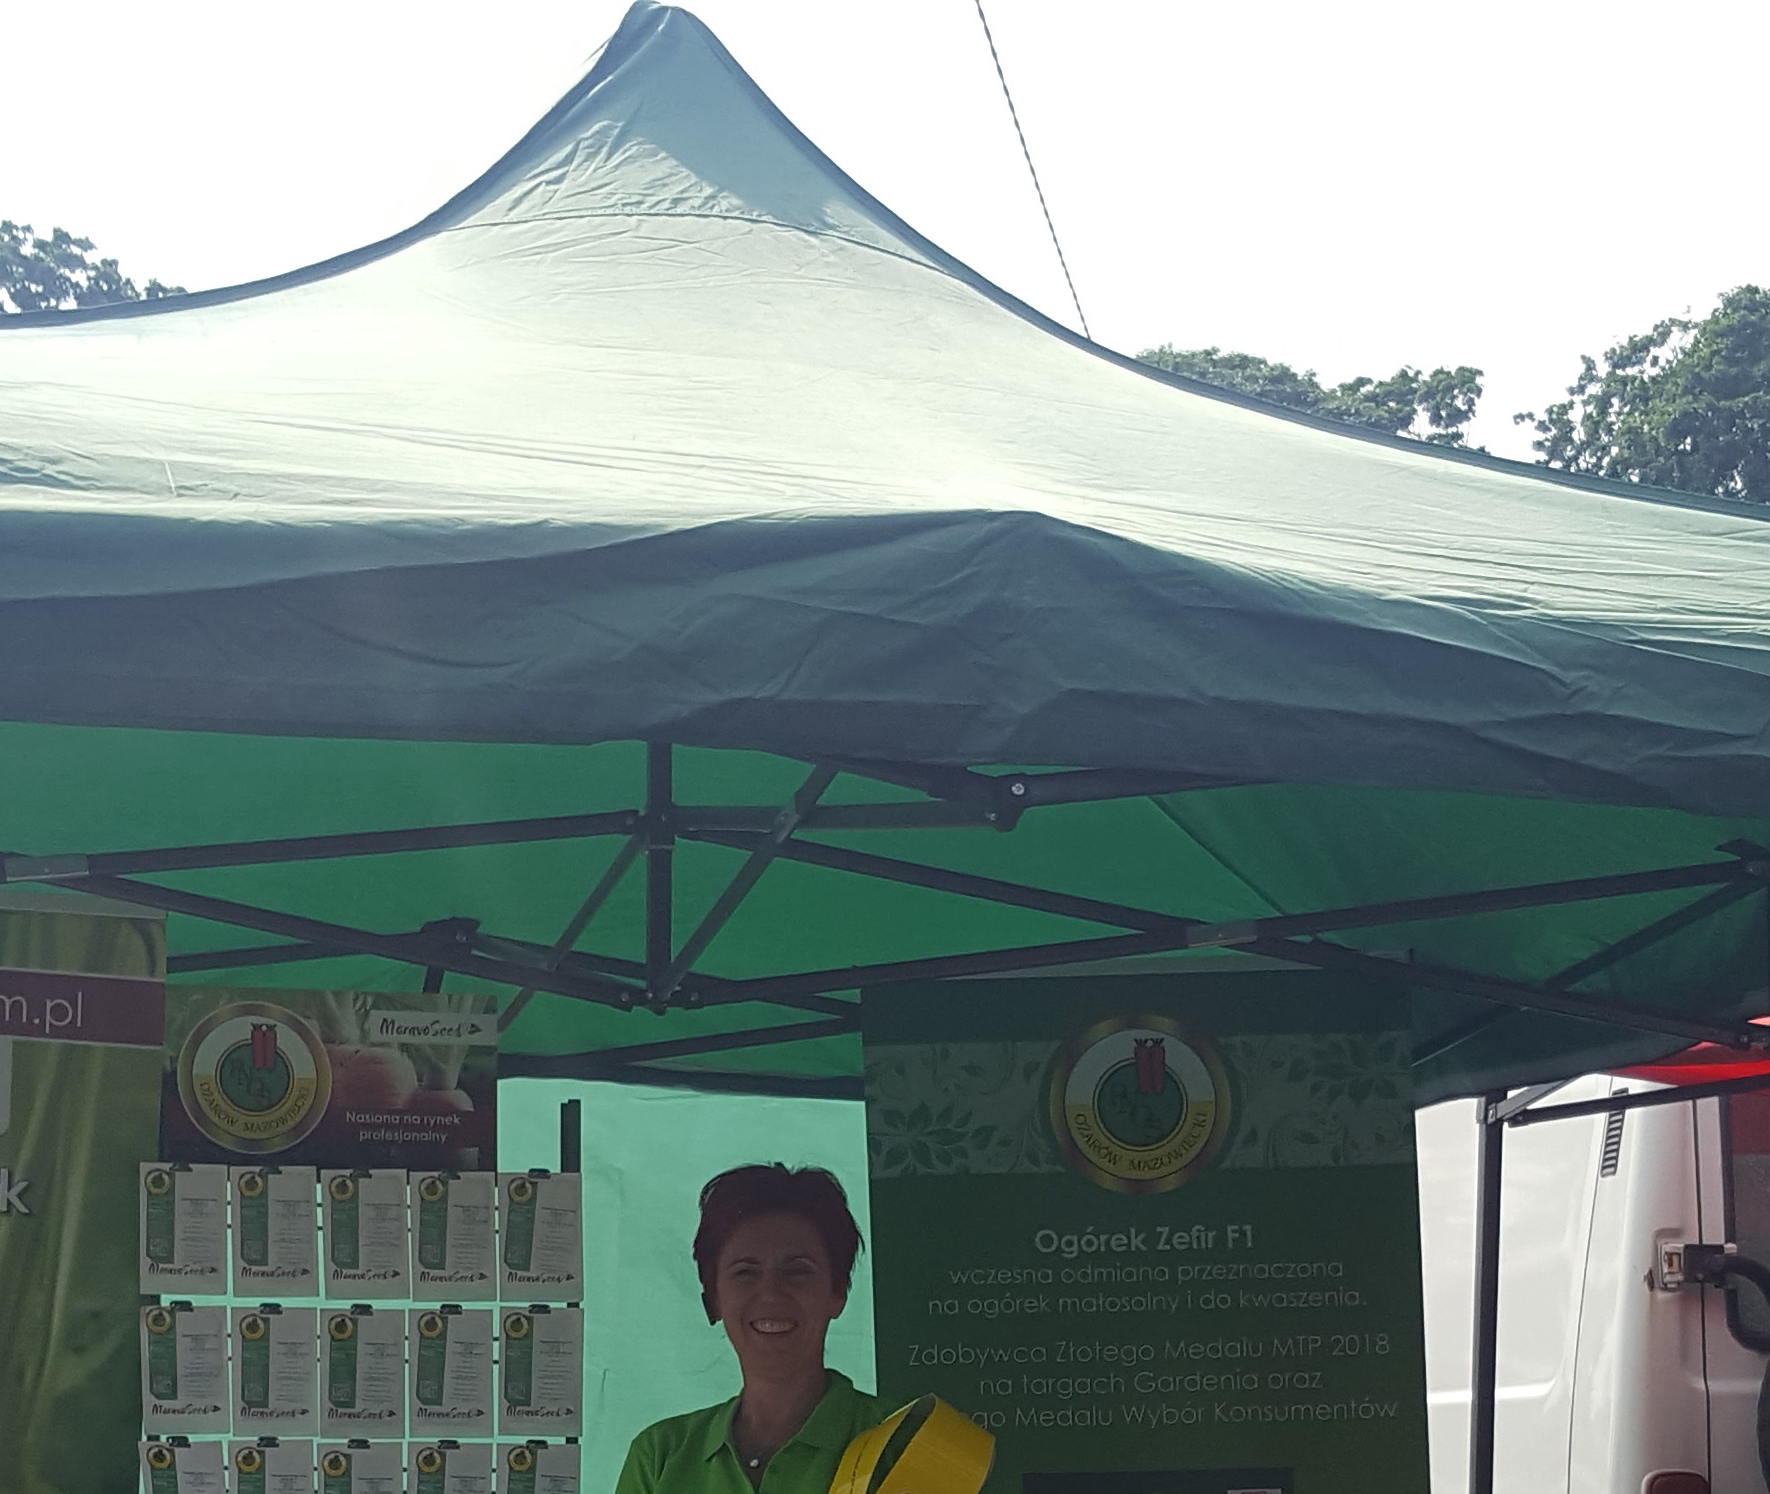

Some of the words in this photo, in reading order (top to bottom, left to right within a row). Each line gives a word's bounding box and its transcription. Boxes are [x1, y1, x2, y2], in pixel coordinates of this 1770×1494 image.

[346, 1110, 401, 1126] Nasiona
[404, 1113, 421, 1126] na
[1034, 1226, 1147, 1259] Ogórek
[1156, 1225, 1216, 1251] Zefir
[1228, 1225, 1254, 1249] F1
[949, 1265, 1054, 1285] wczesna
[1060, 1262, 1169, 1284] odmiana
[1177, 1260, 1343, 1285] przeznaczona
[929, 1298, 960, 1316] na
[967, 1290, 1051, 1319] ogórek
[1058, 1288, 1177, 1315] małosolny
[1199, 1286, 1231, 1309] do
[1239, 1284, 1368, 1309] kwaszenia.
[908, 1342, 1048, 1369] Zdobywca
[1056, 1339, 1155, 1367] Złotego
[1165, 1334, 1262, 1359] Medalu
[1273, 1334, 1322, 1357] MTP
[1331, 1333, 1390, 1357] 2018
[979, 1377, 1012, 1396] na
[1022, 1371, 1125, 1400] targach
[1134, 1369, 1259, 1392] Gardenia
[1267, 1371, 1324, 1390] oraz
[1015, 1406, 1113, 1428] Medalu
[1122, 1400, 1205, 1430] Wybór
[1214, 1397, 1398, 1423] Konsumentów
